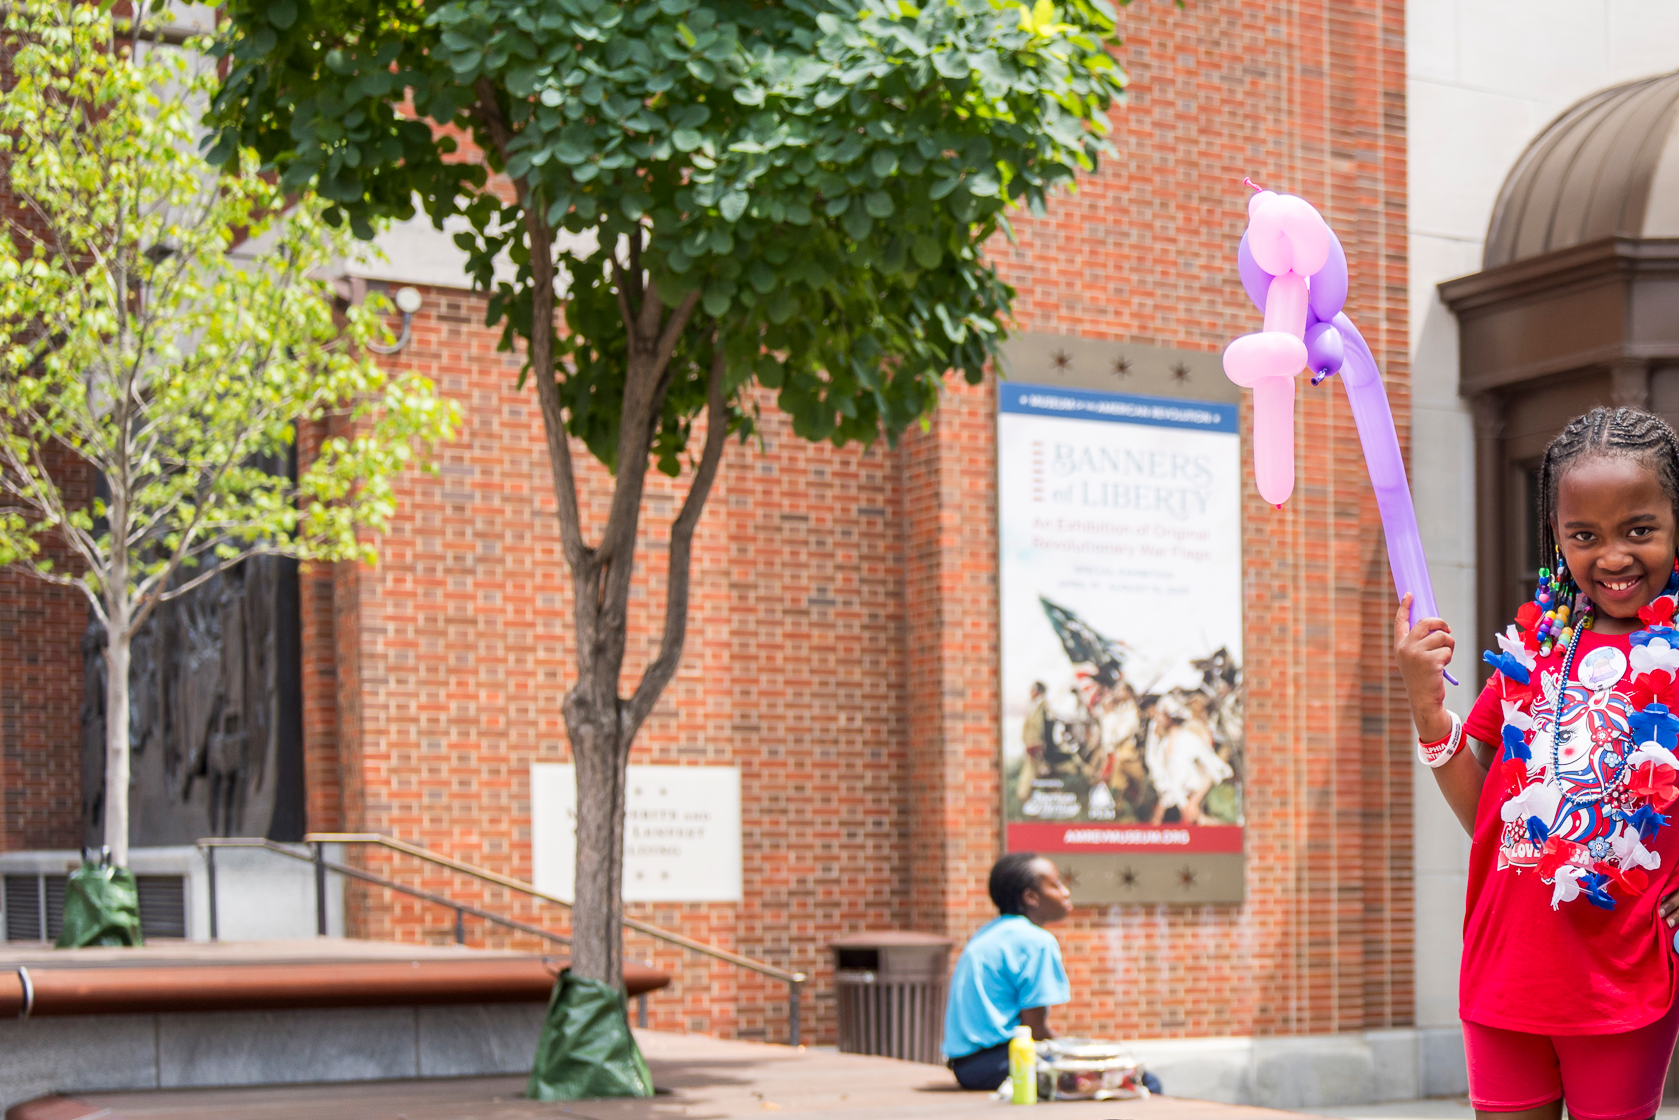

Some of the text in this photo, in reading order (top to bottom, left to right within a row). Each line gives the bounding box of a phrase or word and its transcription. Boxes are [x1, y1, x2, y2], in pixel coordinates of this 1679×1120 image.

[1053, 441, 1213, 488] BANNERS
[1052, 479, 1213, 521] of LIBERTY
[1032, 517, 1211, 543] An Exhibition of Original
[1033, 536, 1136, 558] Revolutionary
[1064, 829, 1190, 845] AMREVMUSEUM.ORG
[1511, 843, 1541, 858] LOVE
